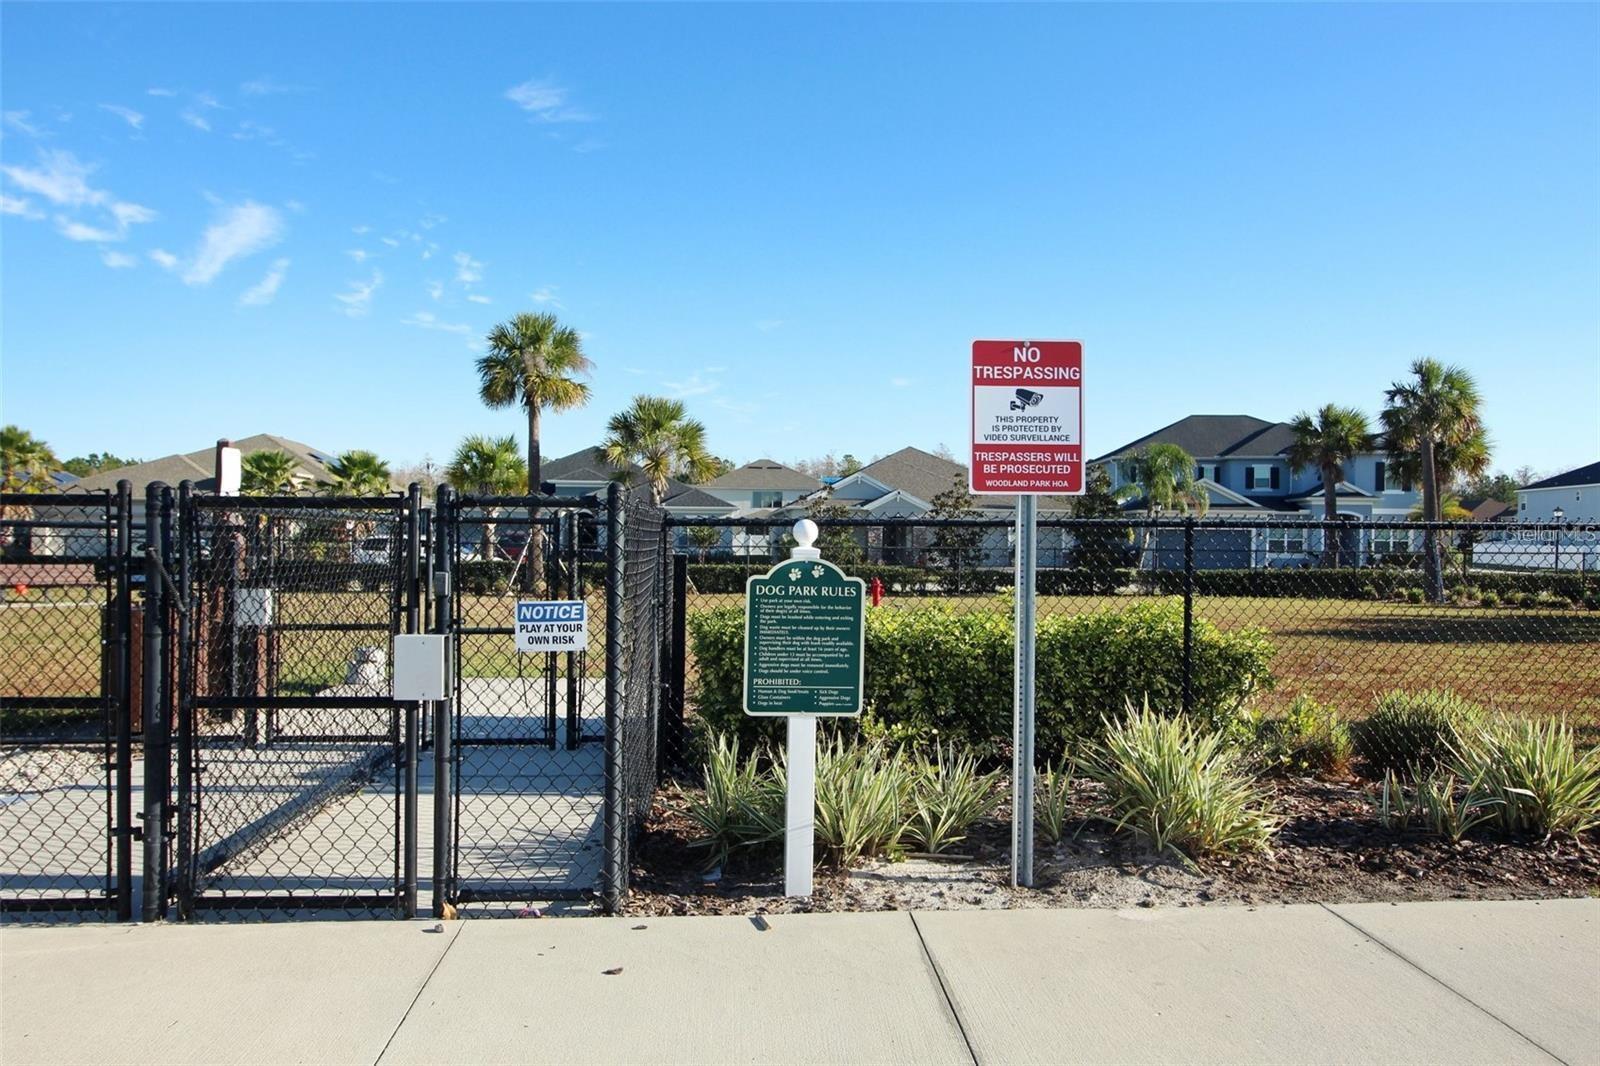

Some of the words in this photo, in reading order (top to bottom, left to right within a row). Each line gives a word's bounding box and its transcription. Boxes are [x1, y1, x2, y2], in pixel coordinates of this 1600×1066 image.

[1014, 348, 1040, 362] NO
[974, 366, 1080, 380] TRESPASSING
[974, 452, 1052, 462] TRESPASSERS
[1054, 453, 1080, 462] WILL
[984, 464, 998, 474] BE
[1000, 465, 1070, 474] PROSECUTED
[756, 585, 785, 596] DOG
[788, 586, 818, 596] PARK
[822, 586, 856, 597] RULES
[520, 606, 582, 619] NOTICE
[520, 624, 542, 633] PLAY
[544, 624, 554, 633] AT
[556, 624, 582, 632] YOUR
[528, 636, 549, 644] OWN
[552, 636, 574, 644] RISK
